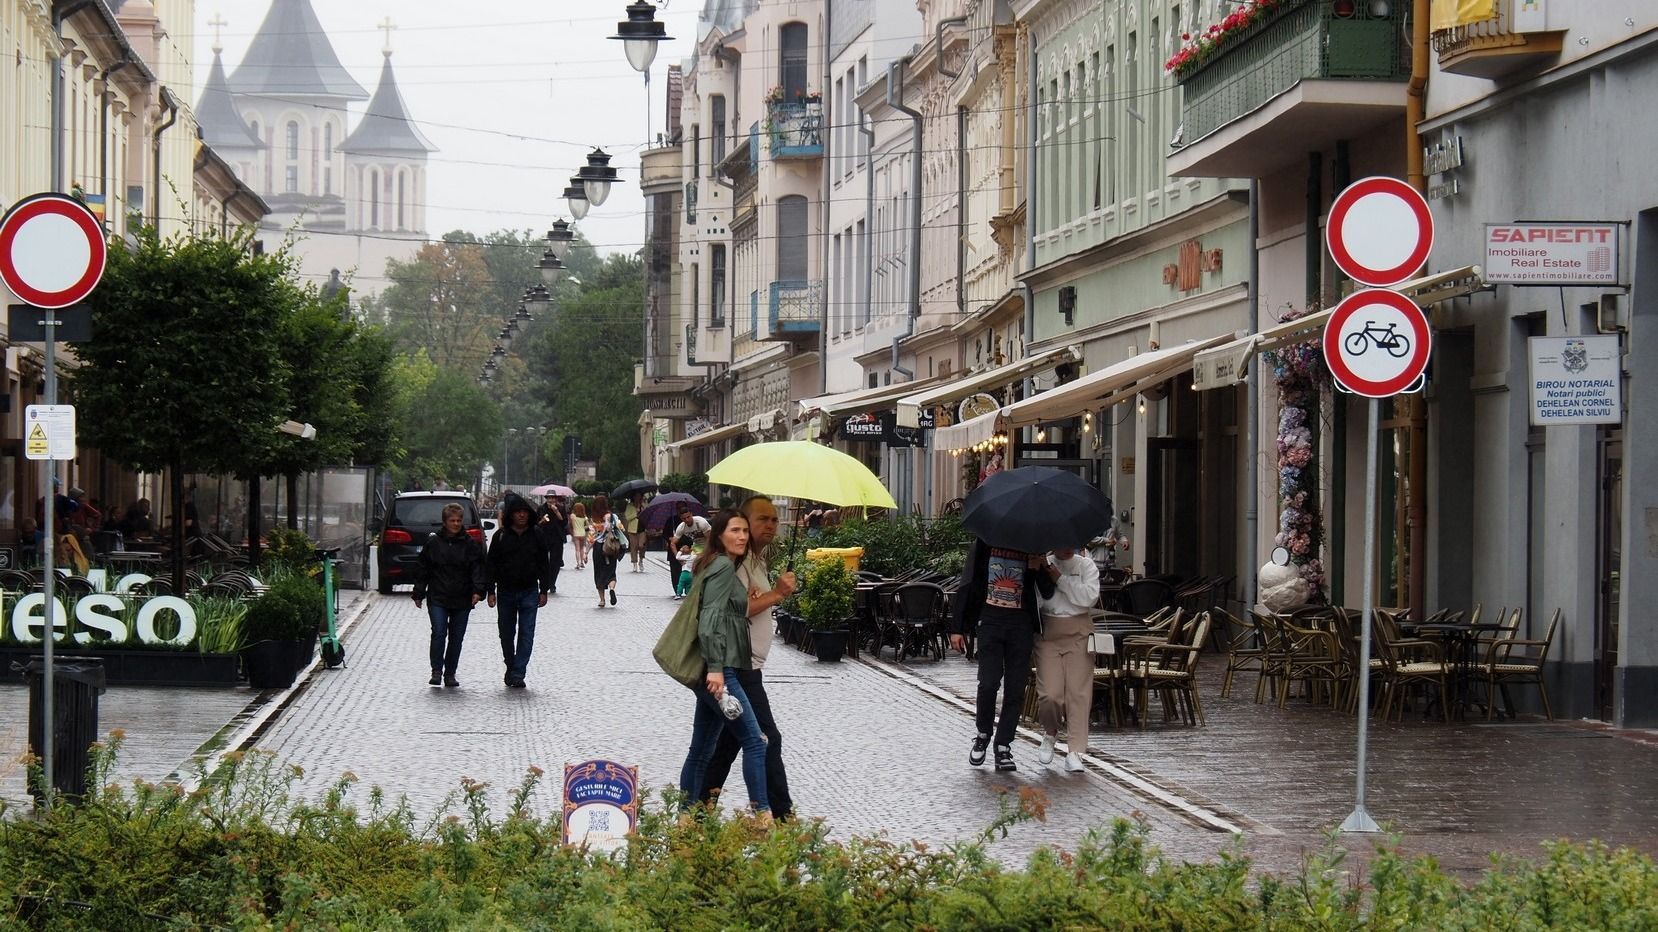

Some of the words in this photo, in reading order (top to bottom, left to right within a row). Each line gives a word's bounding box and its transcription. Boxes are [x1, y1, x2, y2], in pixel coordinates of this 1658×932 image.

[1489, 228, 1612, 243] SAPIENT
[1488, 247, 1548, 258] Imobiliare
[1511, 258, 1539, 268] Real
[1543, 259, 1582, 268] Estate
[1488, 271, 1613, 281] www.sapientimobiliare.com
[1536, 381, 1566, 389] BIROU
[1568, 379, 1615, 388] NOTARIAL
[1547, 390, 1574, 398] Notari
[1576, 389, 1606, 398] publici
[1537, 400, 1580, 408] DEHELEAN
[1582, 399, 1615, 407] CORNEL
[1541, 409, 1584, 417] DEHELEAN
[1586, 408, 1611, 416] SILVIU
[846, 423, 883, 434] gusto
[0, 588, 197, 645] eso
